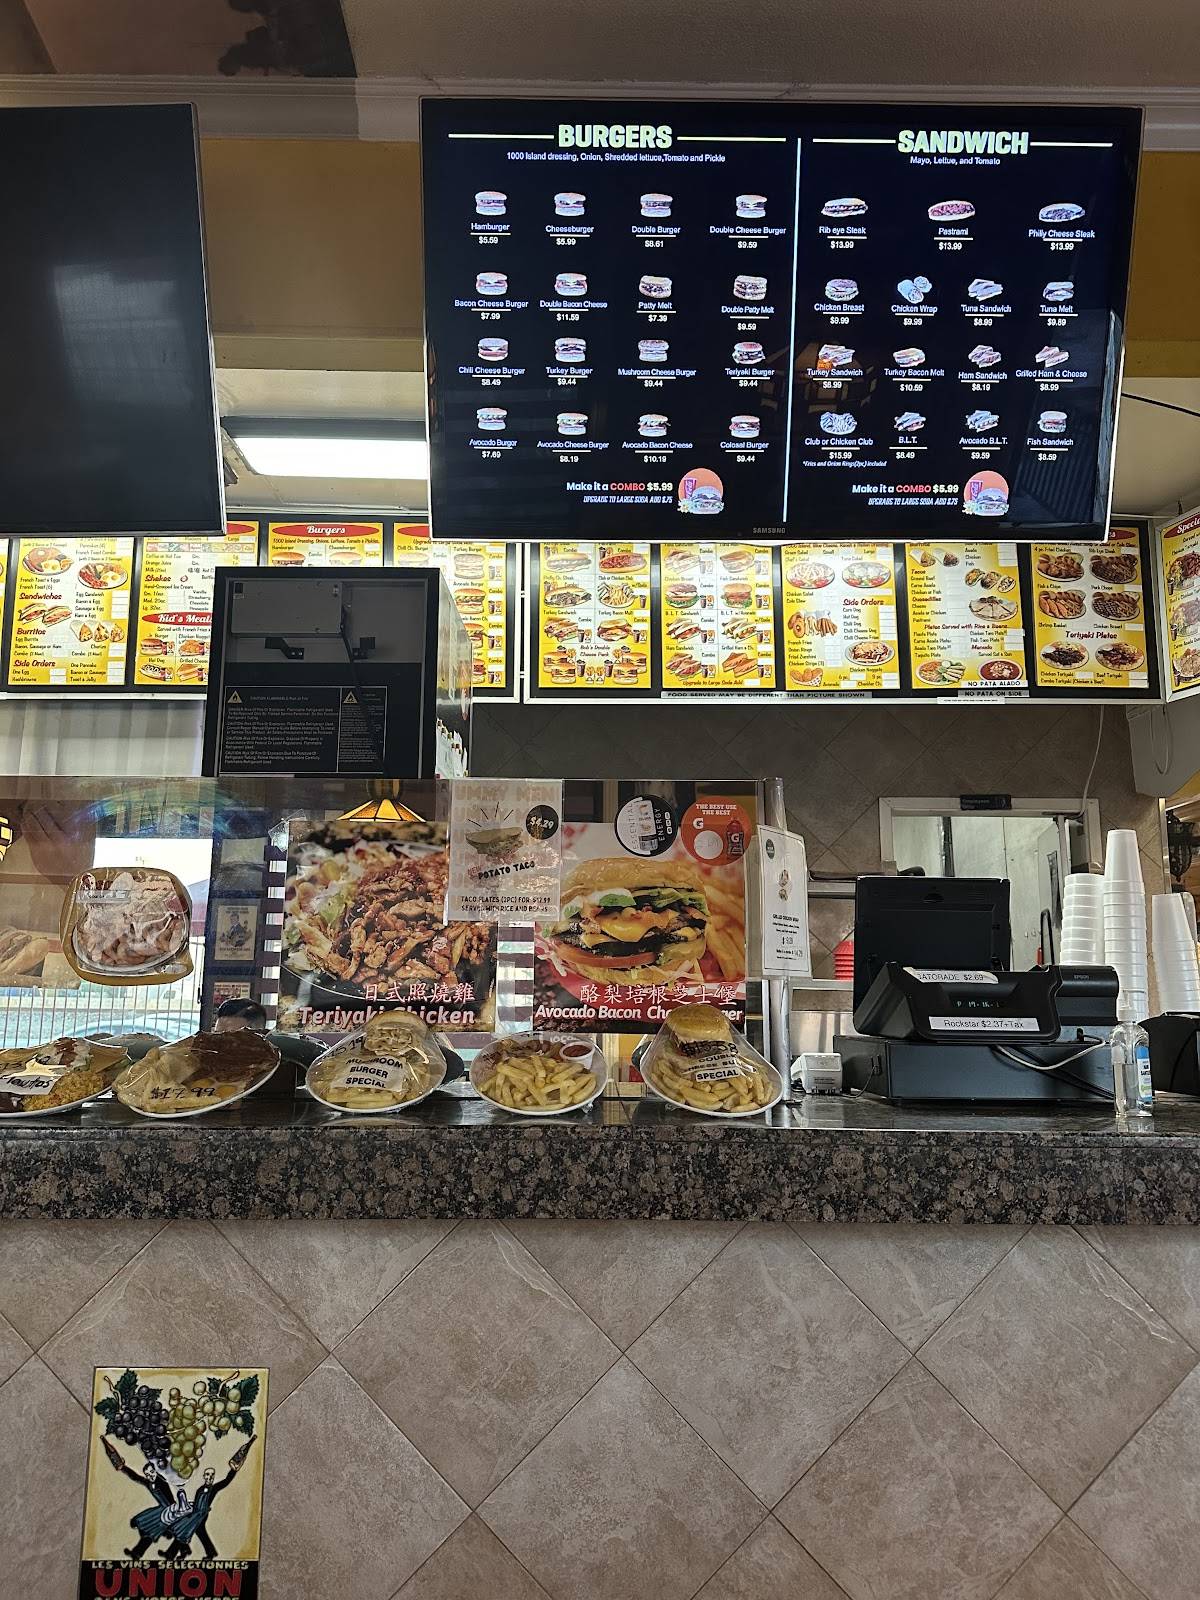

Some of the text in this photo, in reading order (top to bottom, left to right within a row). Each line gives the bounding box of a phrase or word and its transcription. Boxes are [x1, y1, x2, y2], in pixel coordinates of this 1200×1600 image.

[559, 125, 672, 148] BURGERS
[898, 130, 1029, 154] SANDWICH
[910, 157, 932, 165] Mayo,
[471, 223, 510, 232] Hamburger
[545, 225, 594, 234] Cheeseburger
[657, 226, 680, 234] Burger
[763, 227, 786, 235] Burger
[1029, 230, 1095, 239] Philly Cheese Steak
[506, 300, 528, 308] Burger
[540, 300, 562, 308] Double
[638, 302, 656, 310] Patty
[814, 303, 864, 312] Chicken Breast
[744, 306, 760, 314] Patty
[891, 305, 938, 313] Chicken Wrap
[459, 367, 525, 375] Chili Cheese Burger
[546, 367, 593, 376] Turkey Burger
[618, 368, 696, 377] Mushroom Cheese Burger
[725, 368, 775, 377] Teriyaki Burger
[806, 368, 830, 378] Turkey
[884, 368, 907, 377] Turkey
[958, 372, 1007, 380] Ham Sandwich
[589, 441, 609, 449] Burger
[567, 482, 592, 490] Make
[594, 482, 601, 490] it
[647, 482, 673, 491] $5.99
[307, 526, 345, 535] Burgers
[158, 614, 183, 623] Kid's
[1066, 631, 1094, 639] Teriyaki
[530, 816, 554, 829] $4.29
[627, 804, 639, 850] ESSENTIAL
[655, 808, 665, 841] ENERGY
[693, 818, 704, 829] G
[478, 860, 535, 879] POTATO TACO
[365, 983, 475, 1004] 日式照燒雞
[394, 1006, 475, 1024] hicken
[536, 1005, 595, 1018] Avocado
[599, 1006, 641, 1019] Bacon
[944, 1020, 980, 1028] Rockstar
[346, 1057, 403, 1069] MUROOM
[350, 1066, 388, 1079] BURGER
[698, 1070, 739, 1080] SPECIAL
[346, 1077, 386, 1088] SPECIAL
[96, 1568, 242, 1597] UNION
